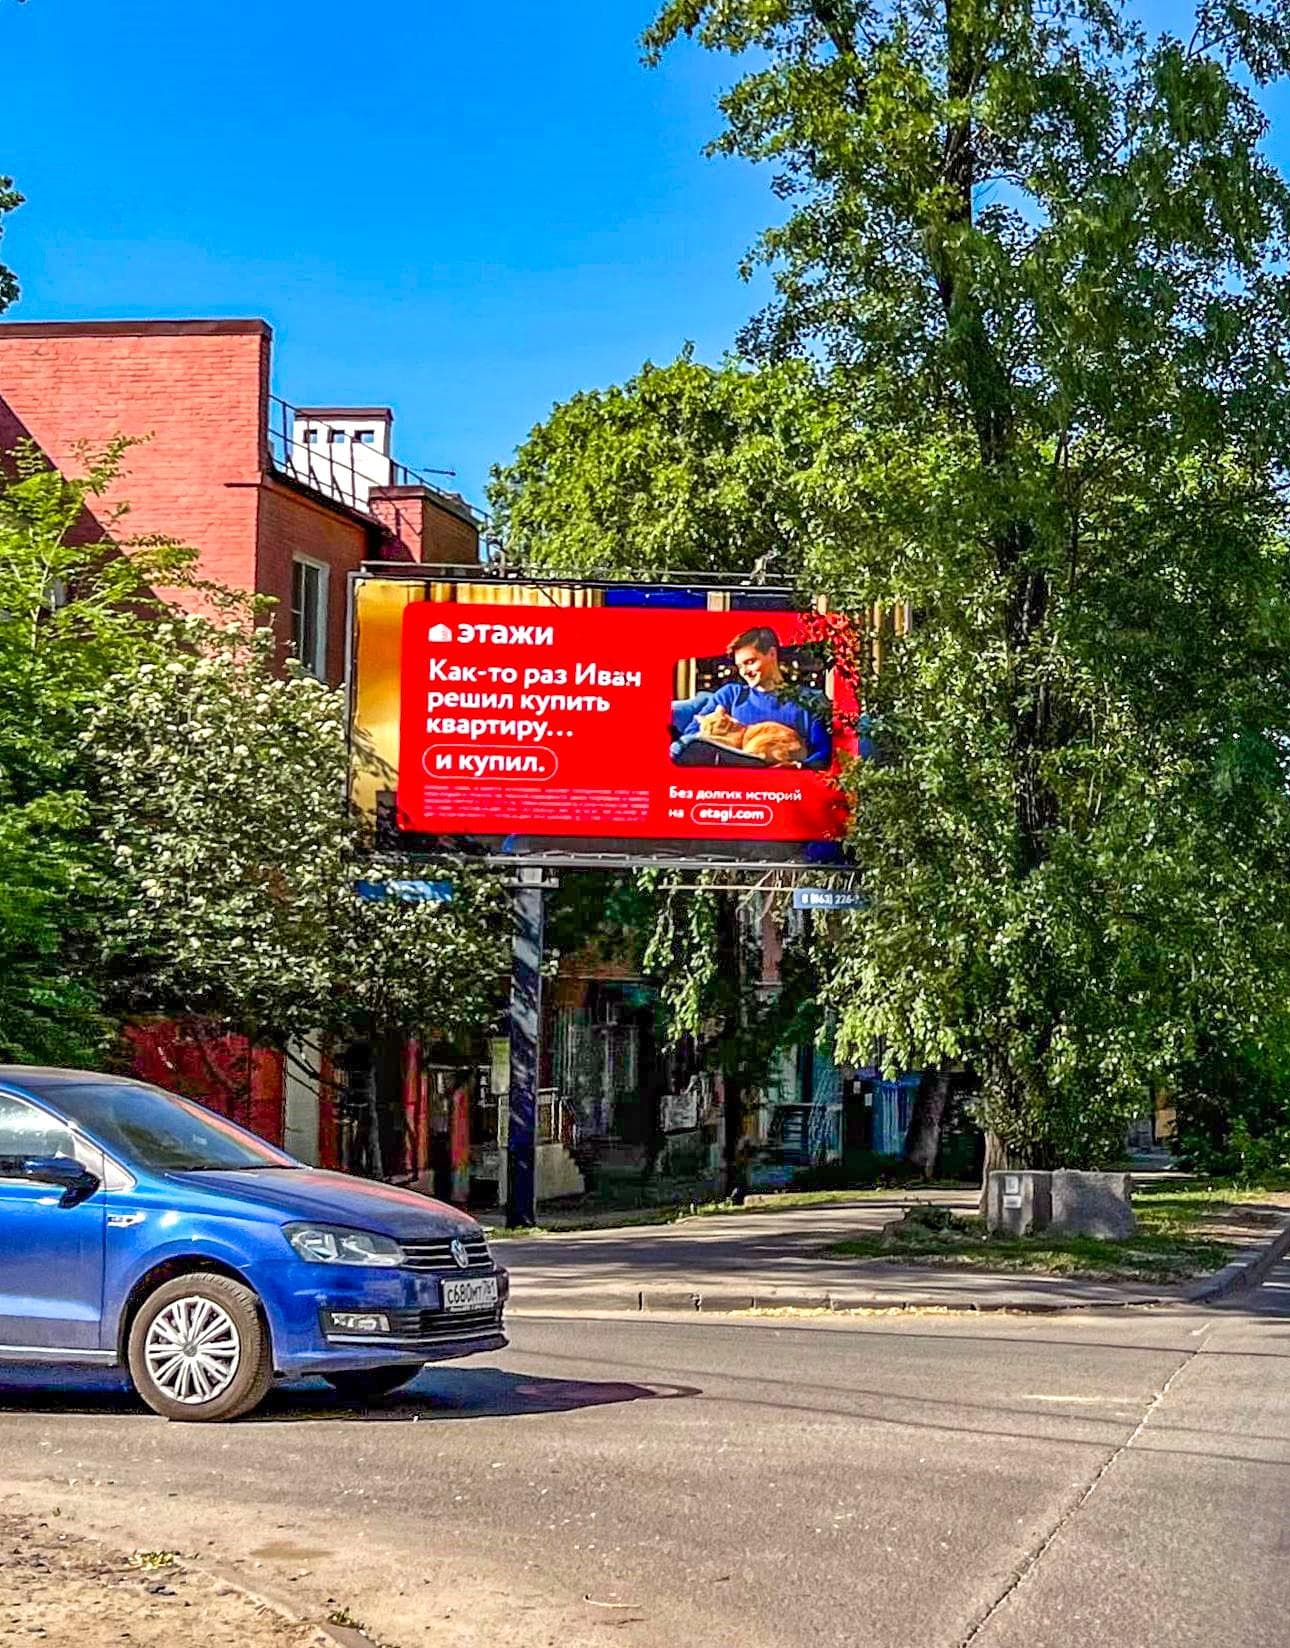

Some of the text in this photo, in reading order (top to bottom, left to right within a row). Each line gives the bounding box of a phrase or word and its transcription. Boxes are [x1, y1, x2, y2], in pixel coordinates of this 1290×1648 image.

[429, 658, 641, 688] Как-то раз Иван
[427, 691, 610, 716] решил купить
[426, 717, 574, 742] квартиру...
[435, 754, 545, 777] и купил.
[669, 786, 802, 803] Без долгих историй
[668, 806, 765, 822] на etagi.com
